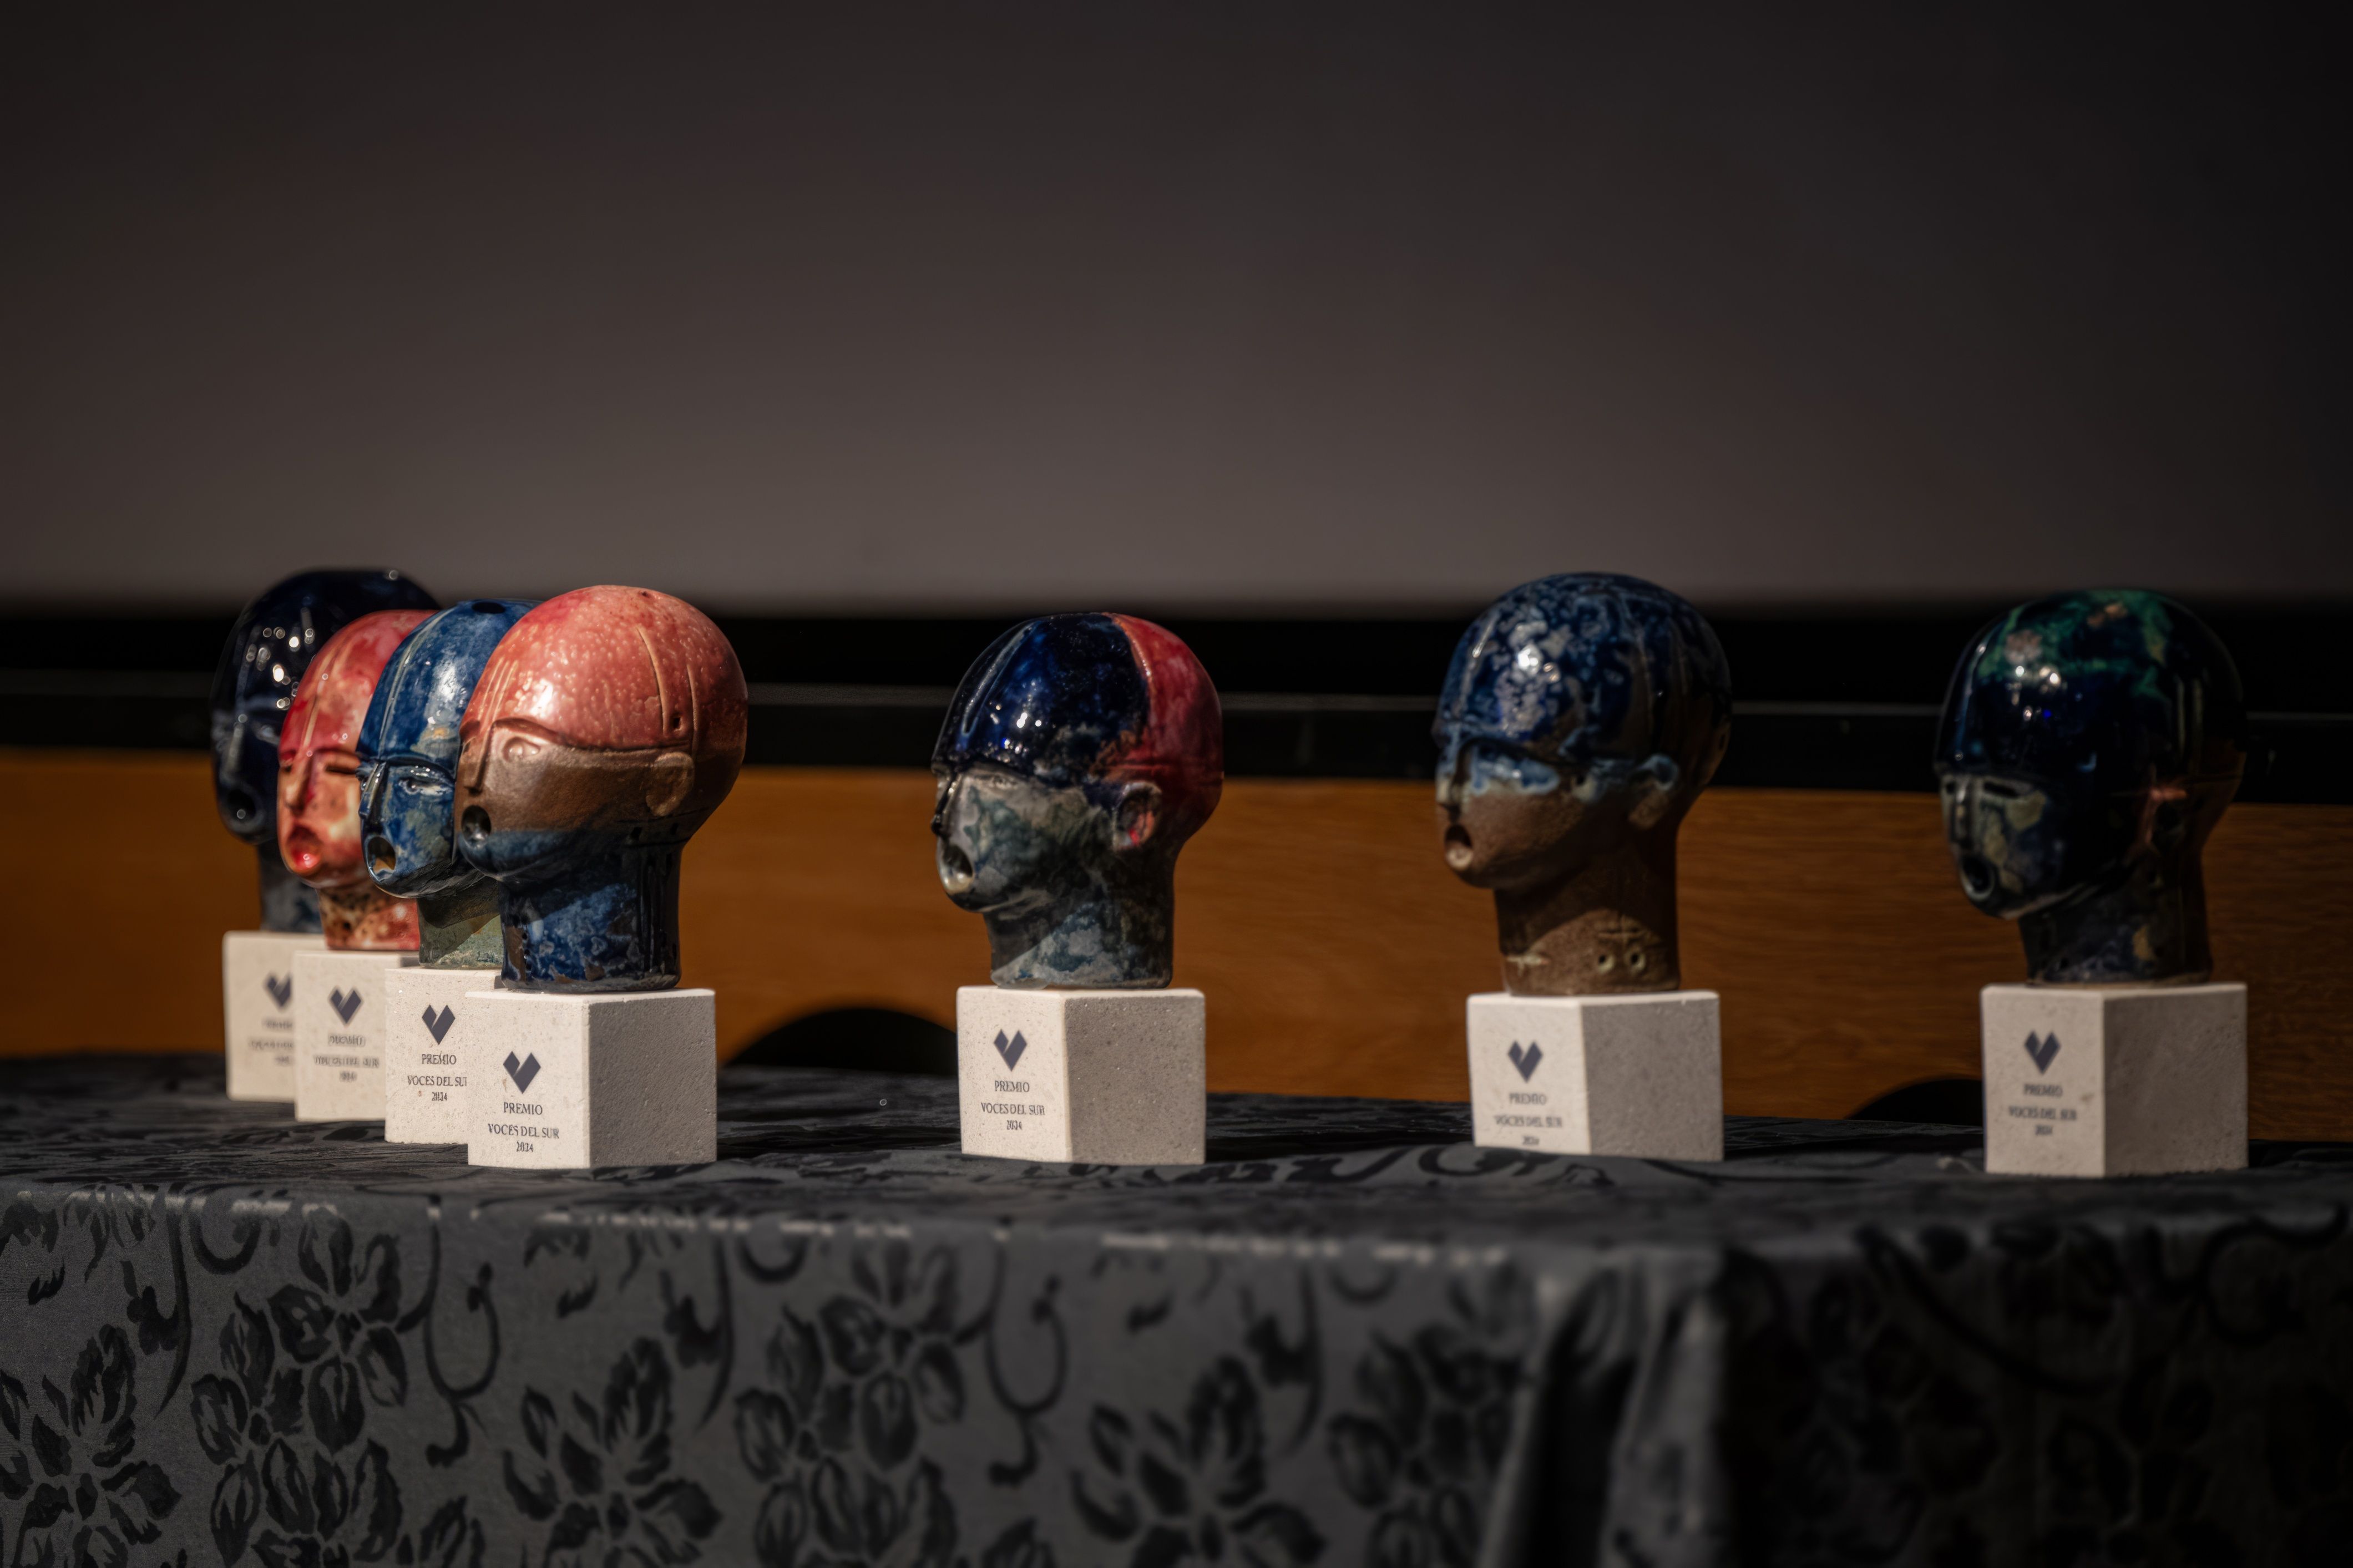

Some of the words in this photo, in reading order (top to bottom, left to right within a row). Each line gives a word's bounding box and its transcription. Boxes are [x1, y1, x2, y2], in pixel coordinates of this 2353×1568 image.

[407, 1075, 434, 1086] VOCES
[437, 1077, 452, 1087] DEL
[994, 1080, 1030, 1092] PREMIO
[504, 1102, 543, 1115] PREMIO
[980, 1102, 1008, 1114] VOCES
[1010, 1104, 1025, 1114] DEL
[488, 1123, 518, 1135] VOCES
[521, 1126, 540, 1137] DEL
[542, 1128, 559, 1139] SUR
[516, 1141, 533, 1152] 2024
